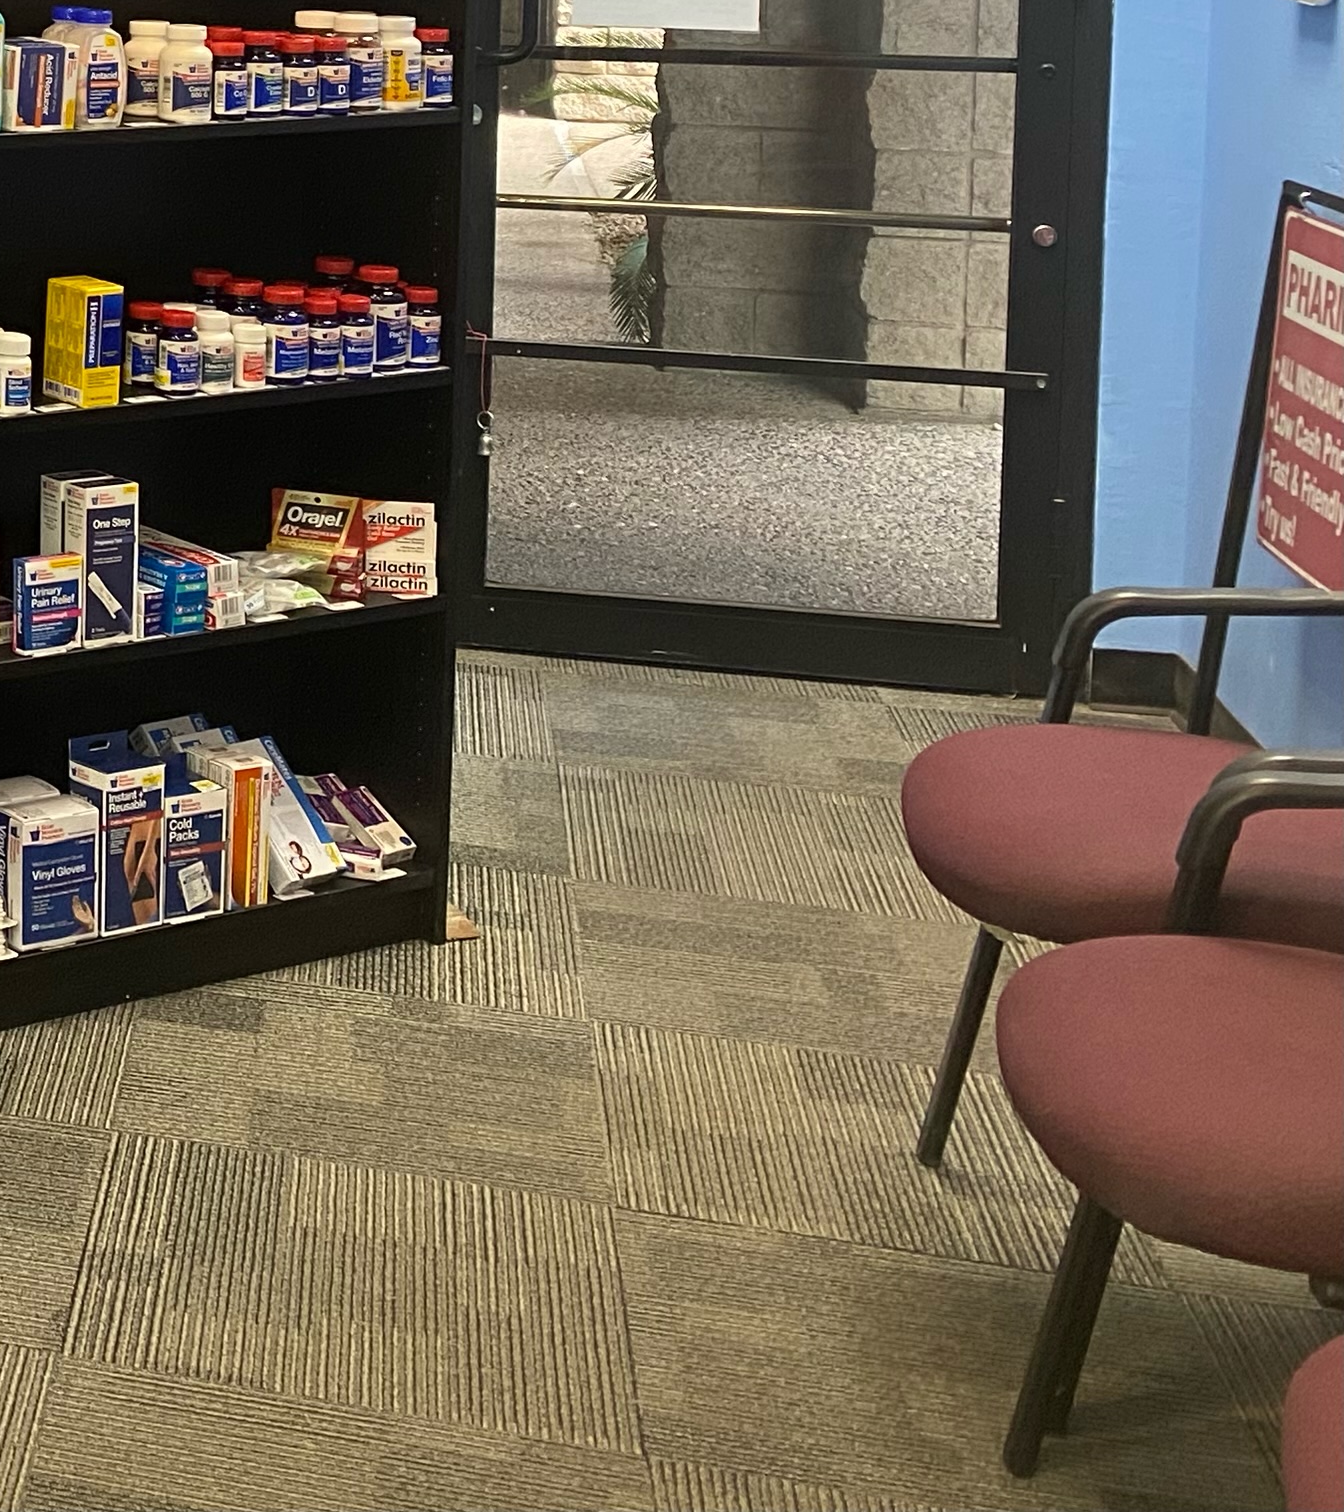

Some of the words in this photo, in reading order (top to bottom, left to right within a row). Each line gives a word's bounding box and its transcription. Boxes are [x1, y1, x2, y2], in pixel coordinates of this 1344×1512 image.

[90, 72, 117, 80] Antacid
[1279, 355, 1293, 394] ALL
[1273, 405, 1294, 442] Low
[1295, 415, 1321, 459] Cash
[1268, 447, 1290, 489] Fast
[1291, 468, 1300, 497] &
[1301, 473, 1343, 536] Friendly
[93, 519, 110, 529] One
[112, 516, 131, 528] Step
[287, 507, 343, 527] Orajel
[368, 513, 425, 527] zilactin
[1263, 495, 1280, 542] Try
[1281, 511, 1295, 547] us!
[279, 524, 298, 536] 4X
[369, 561, 426, 575] zilactin
[371, 576, 428, 591] zilactin
[31, 586, 62, 597] Urinary
[31, 598, 54, 607] Pain
[55, 594, 75, 605] Relief
[108, 800, 147, 813] Reusable
[169, 820, 193, 831] Cold
[170, 830, 199, 842] Packs
[32, 867, 54, 881] Vinyl
[56, 864, 86, 877] Gloves
